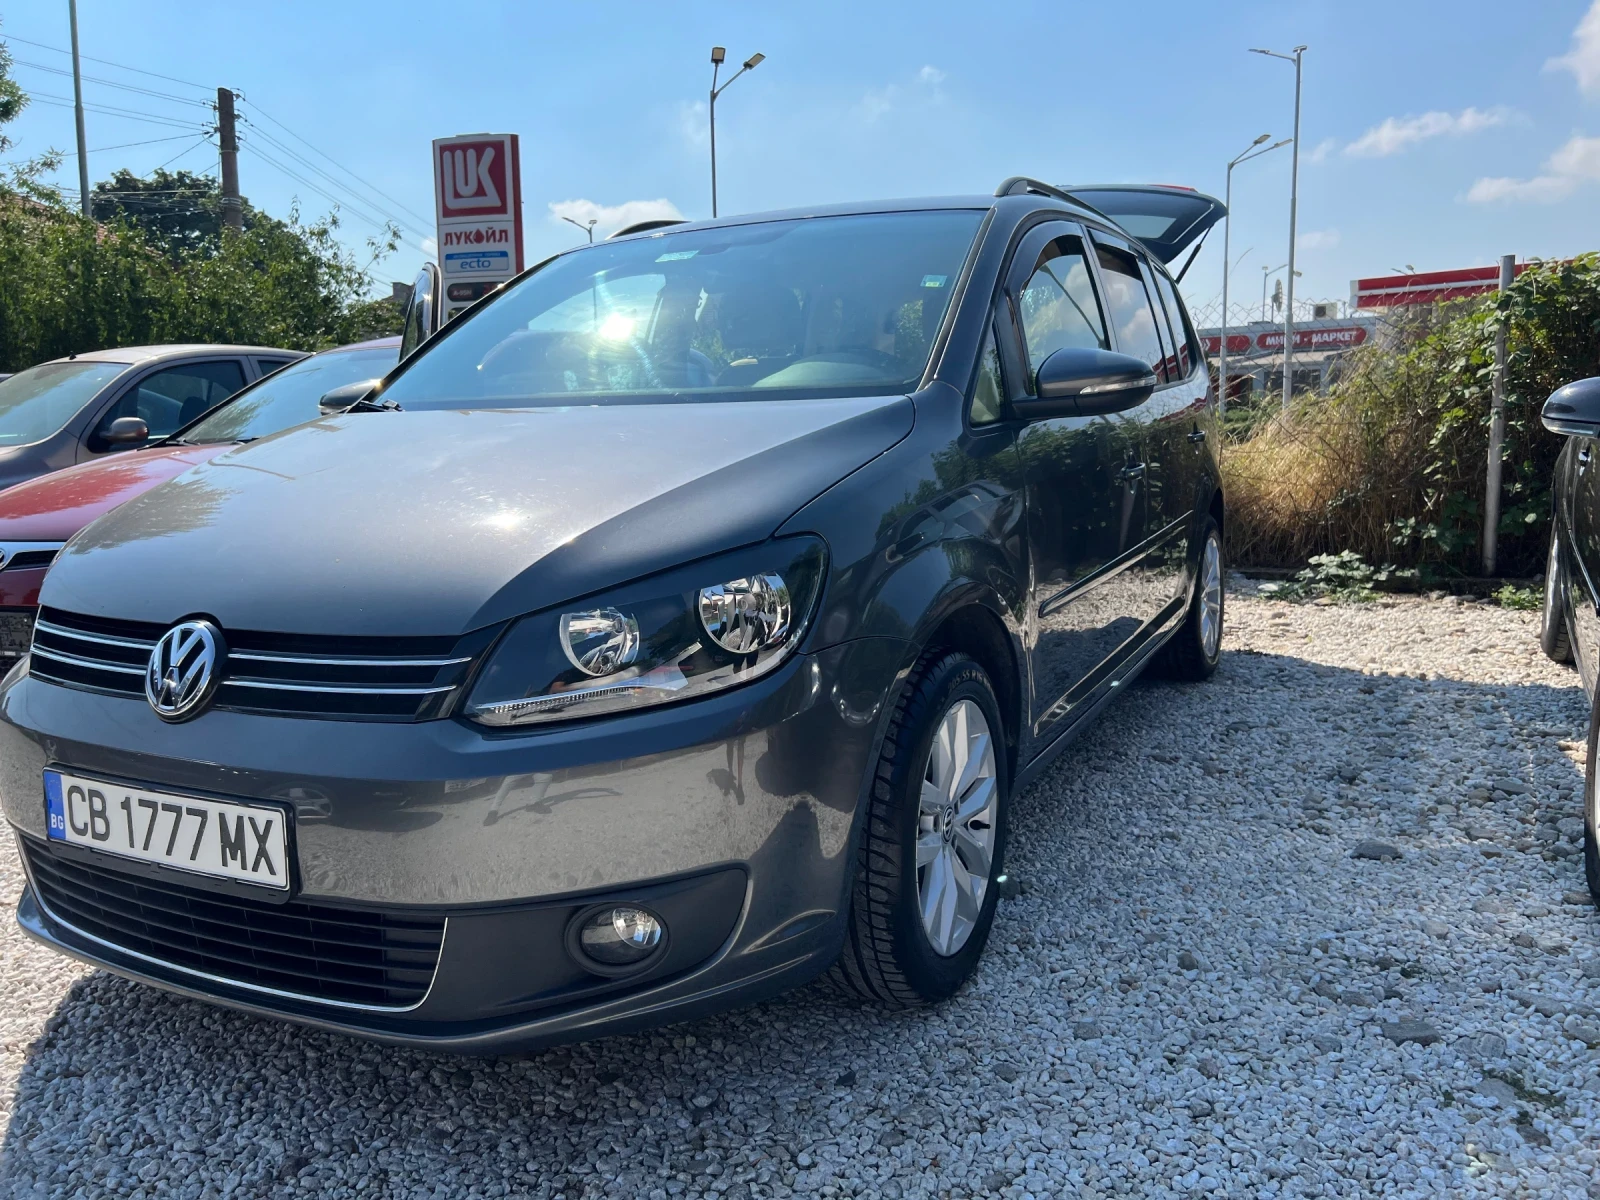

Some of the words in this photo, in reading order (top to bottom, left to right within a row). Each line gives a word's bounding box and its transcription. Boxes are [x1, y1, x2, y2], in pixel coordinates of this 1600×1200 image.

[443, 226, 509, 246] ЛУКОЙЛ
[460, 258, 491, 270] ecto
[1265, 333, 1301, 346] МИИ
[1311, 331, 1357, 343] МАРКЕТ
[50, 813, 65, 831] BG
[67, 785, 111, 842] CB
[120, 796, 208, 861] 1777
[218, 812, 278, 876] MX
